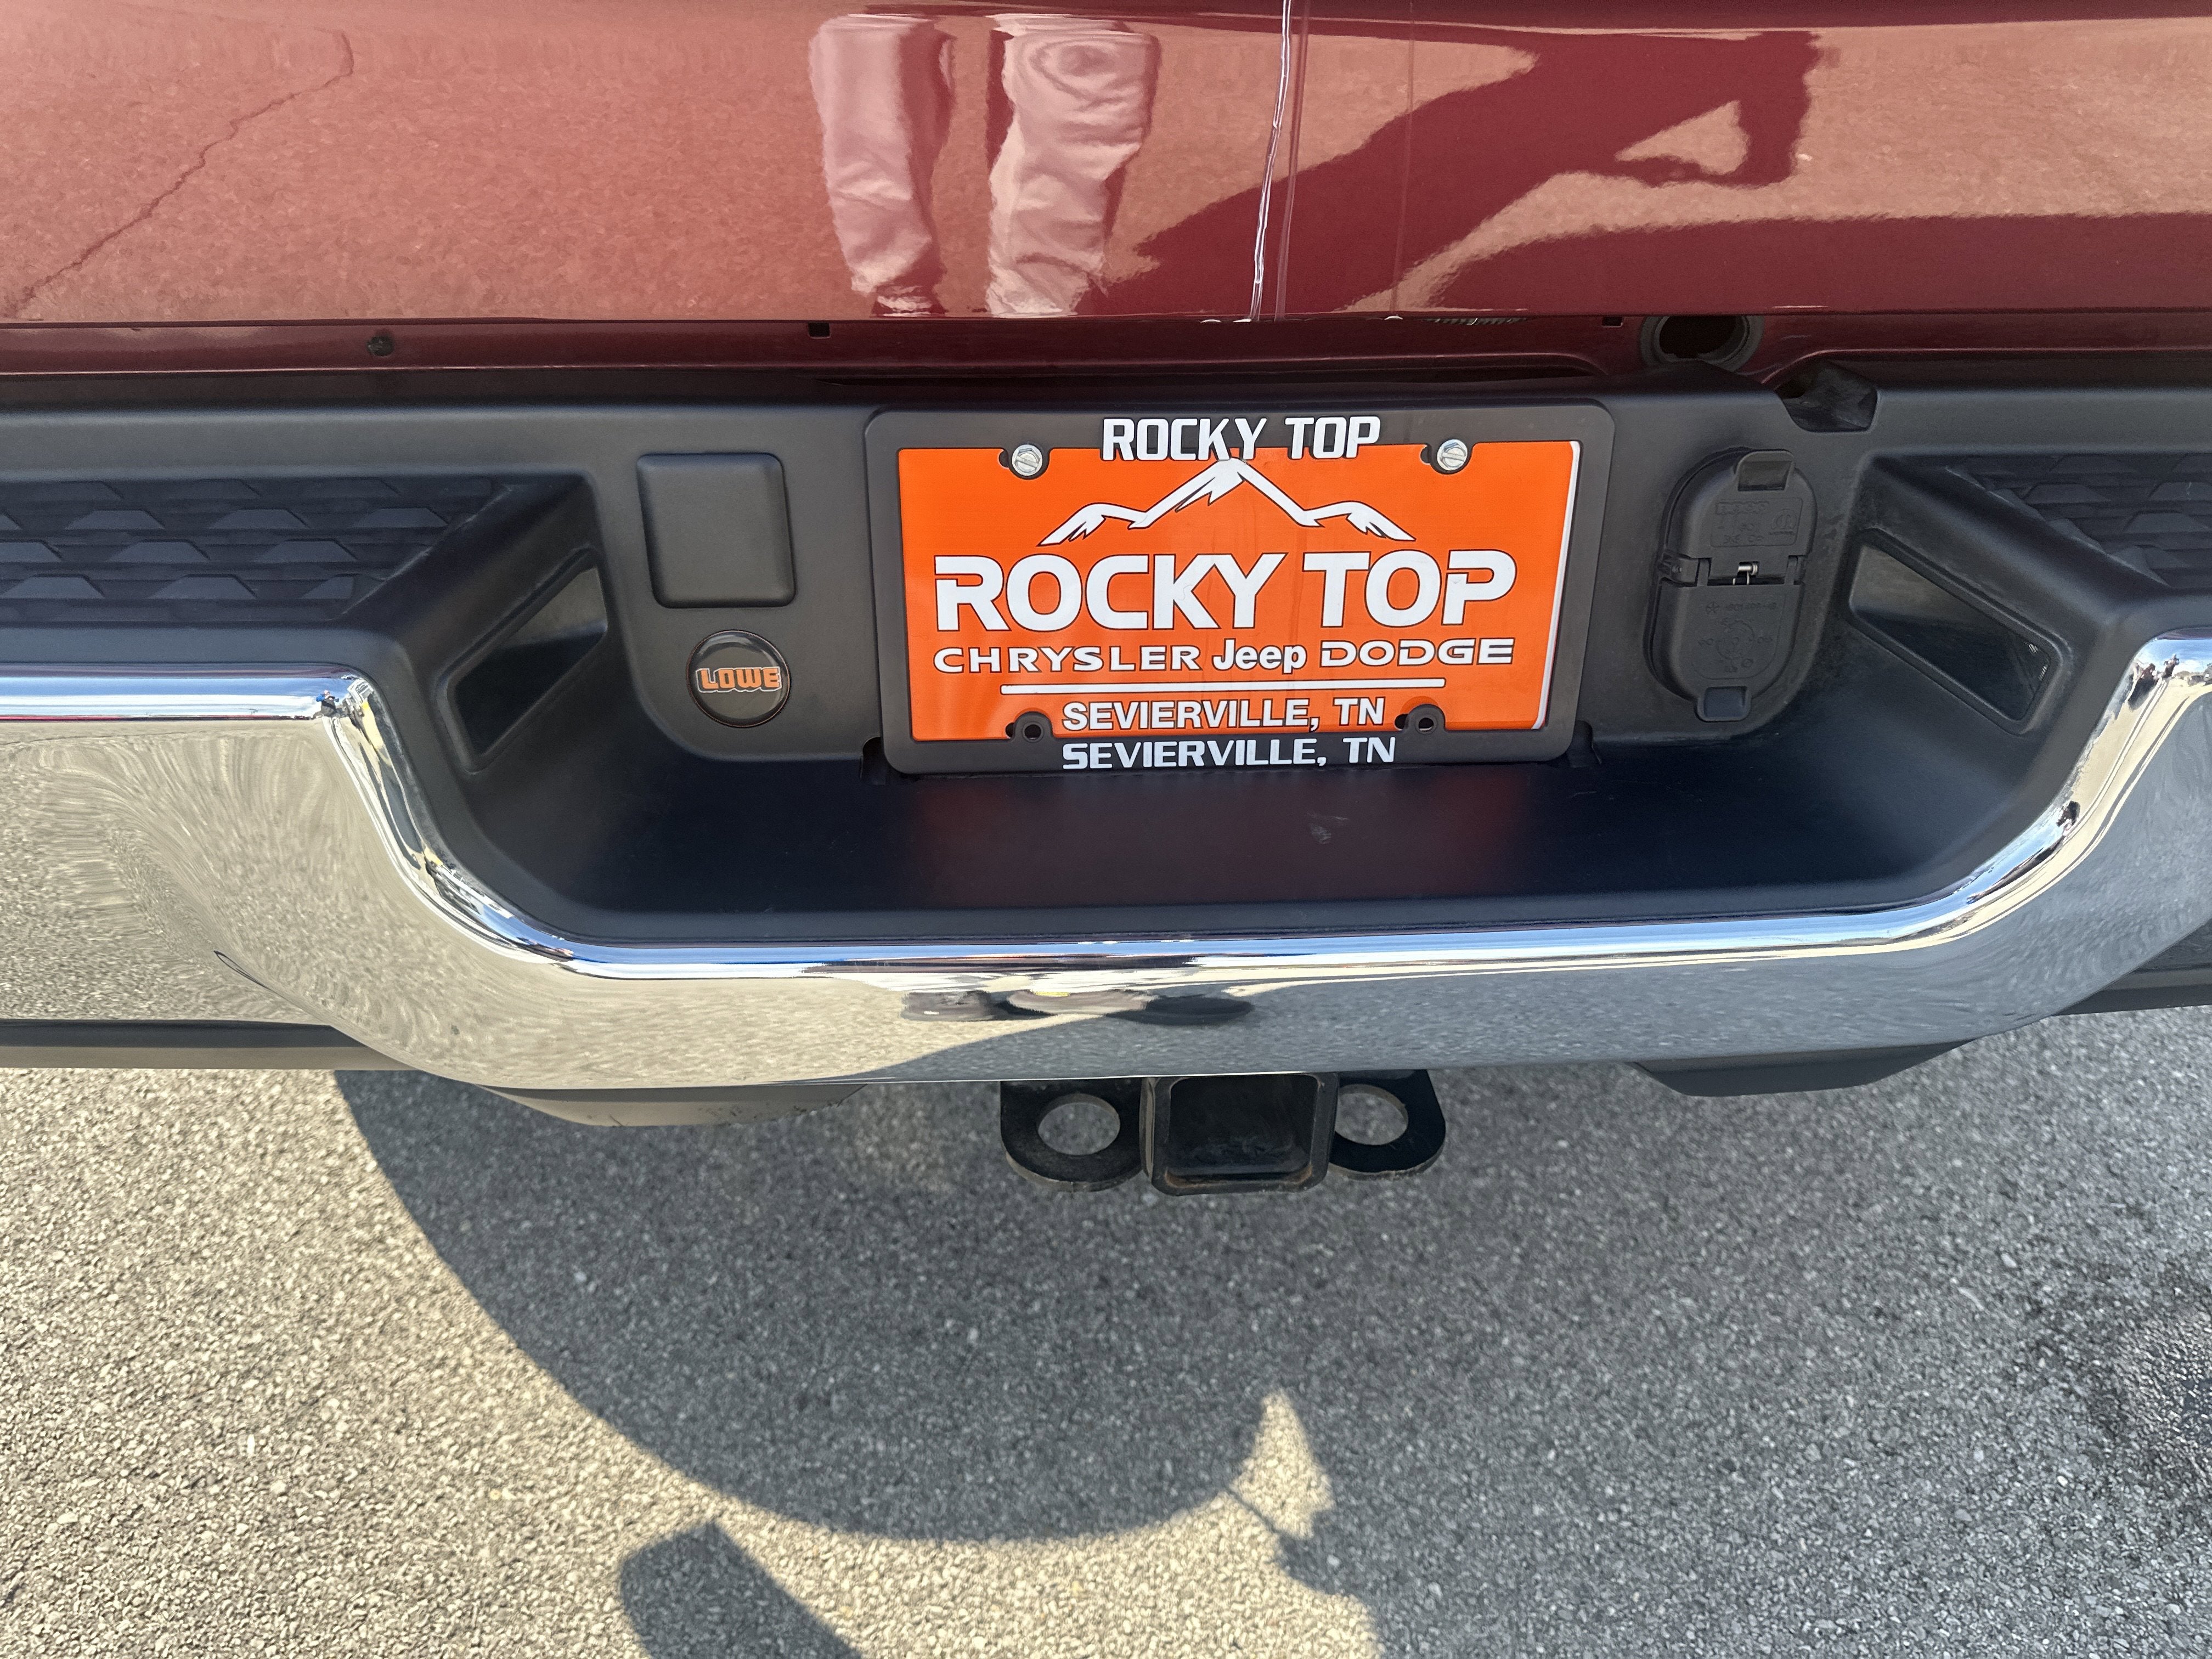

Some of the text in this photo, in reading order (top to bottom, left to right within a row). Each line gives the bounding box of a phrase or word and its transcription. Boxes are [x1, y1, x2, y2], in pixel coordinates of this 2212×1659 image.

[1103, 416, 1381, 461] ROCKY TOP
[935, 550, 1516, 631] ROCKY TOP
[934, 638, 1514, 674] CHRYSLER Jeep DODGE
[696, 667, 782, 692] LOWE
[1063, 697, 1385, 731] SEVIERVILLE, TN
[1063, 737, 1396, 770] SEVIERVILLE, TN
